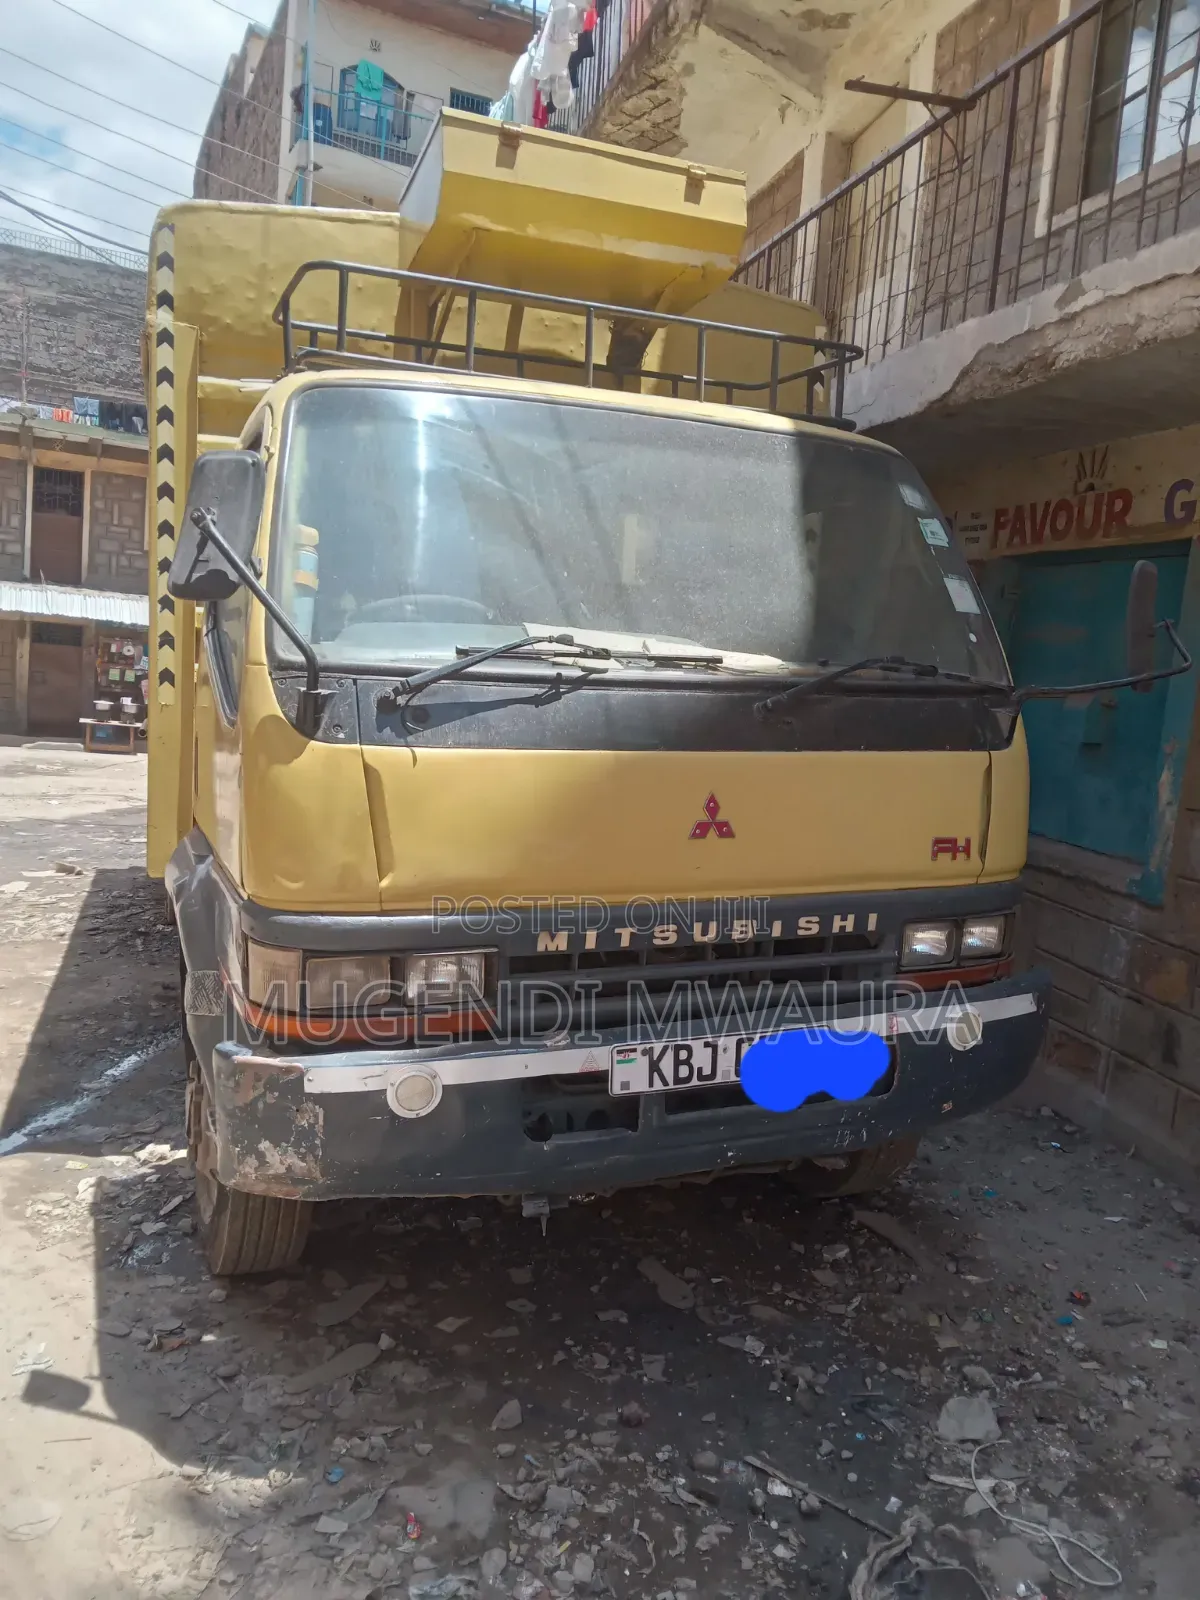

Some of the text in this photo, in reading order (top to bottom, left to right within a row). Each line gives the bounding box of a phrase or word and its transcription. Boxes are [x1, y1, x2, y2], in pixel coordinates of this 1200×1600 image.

[991, 488, 1134, 550] FAVOUR
[931, 837, 971, 861] FH
[537, 913, 878, 952] MITSUBISHI
[648, 1043, 718, 1088] KBJ
